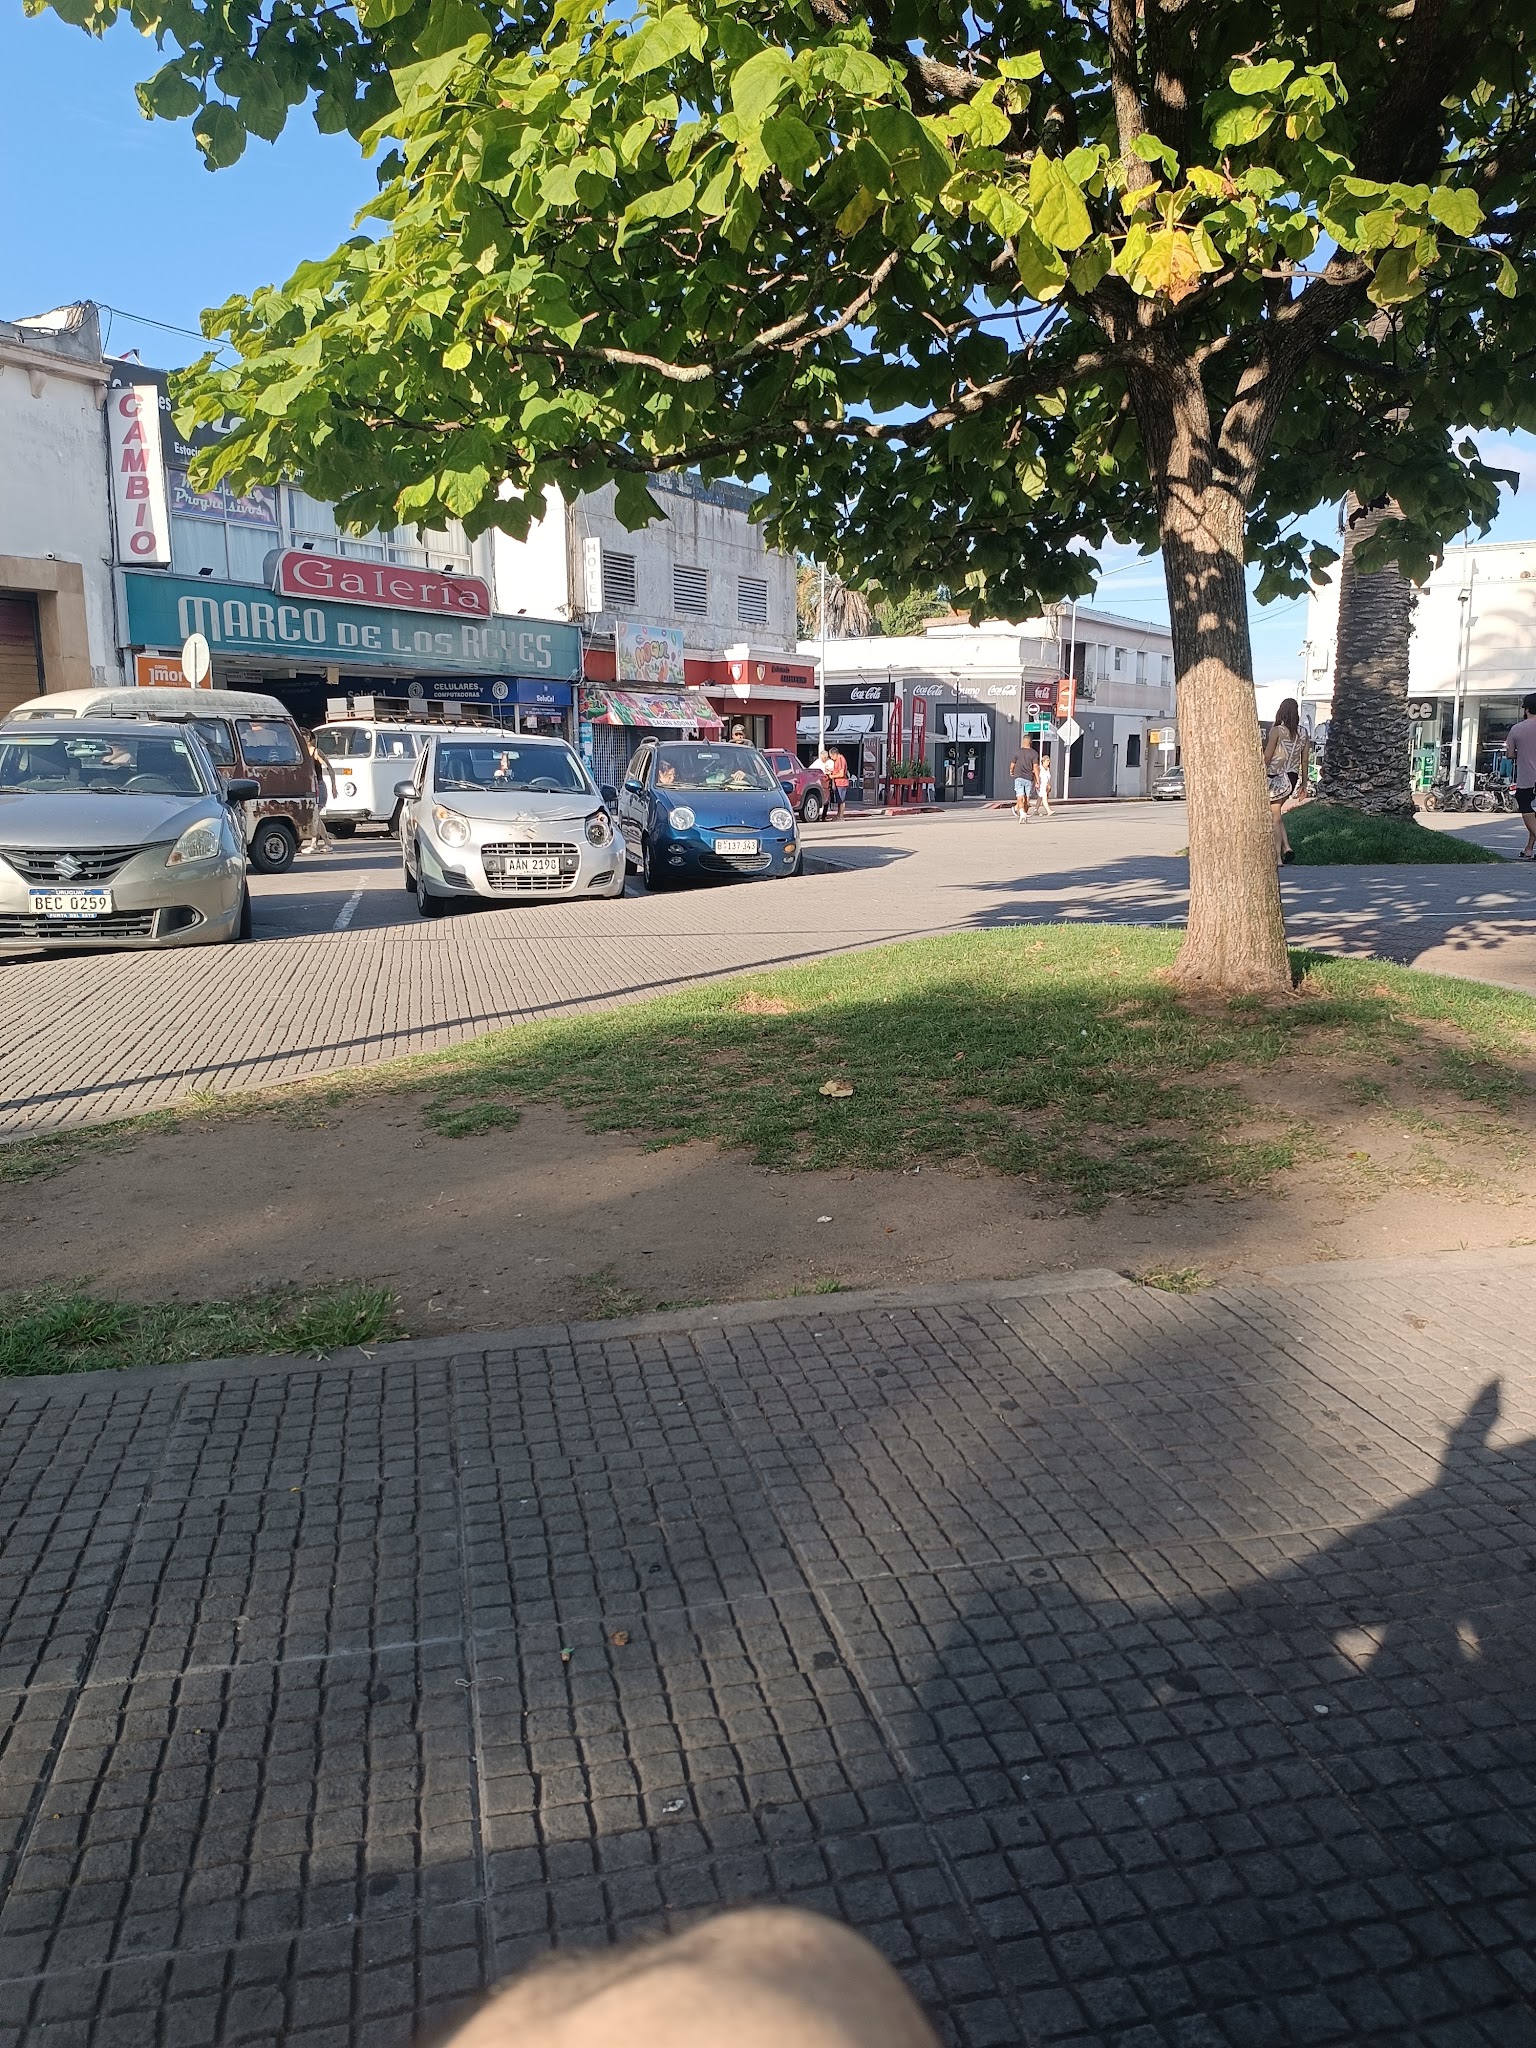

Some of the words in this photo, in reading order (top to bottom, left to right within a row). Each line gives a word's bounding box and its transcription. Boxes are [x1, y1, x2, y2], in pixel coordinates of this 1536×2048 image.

[118, 393, 157, 555] CAMBIO
[586, 544, 598, 607] HOTEL
[292, 559, 482, 610] Galería
[178, 595, 326, 644] MARCO
[337, 622, 382, 650] DE
[391, 628, 453, 655] LOS
[462, 625, 552, 669] REYES
[434, 682, 479, 691] CELULARES
[850, 686, 883, 700] Coca-Cola
[912, 684, 944, 696] Coca-Cola
[536, 694, 555, 703] SoluCel
[1408, 702, 1433, 720] ce
[509, 858, 528, 870] AAN
[35, 896, 62, 910] BEC
[70, 896, 107, 910] 0259
